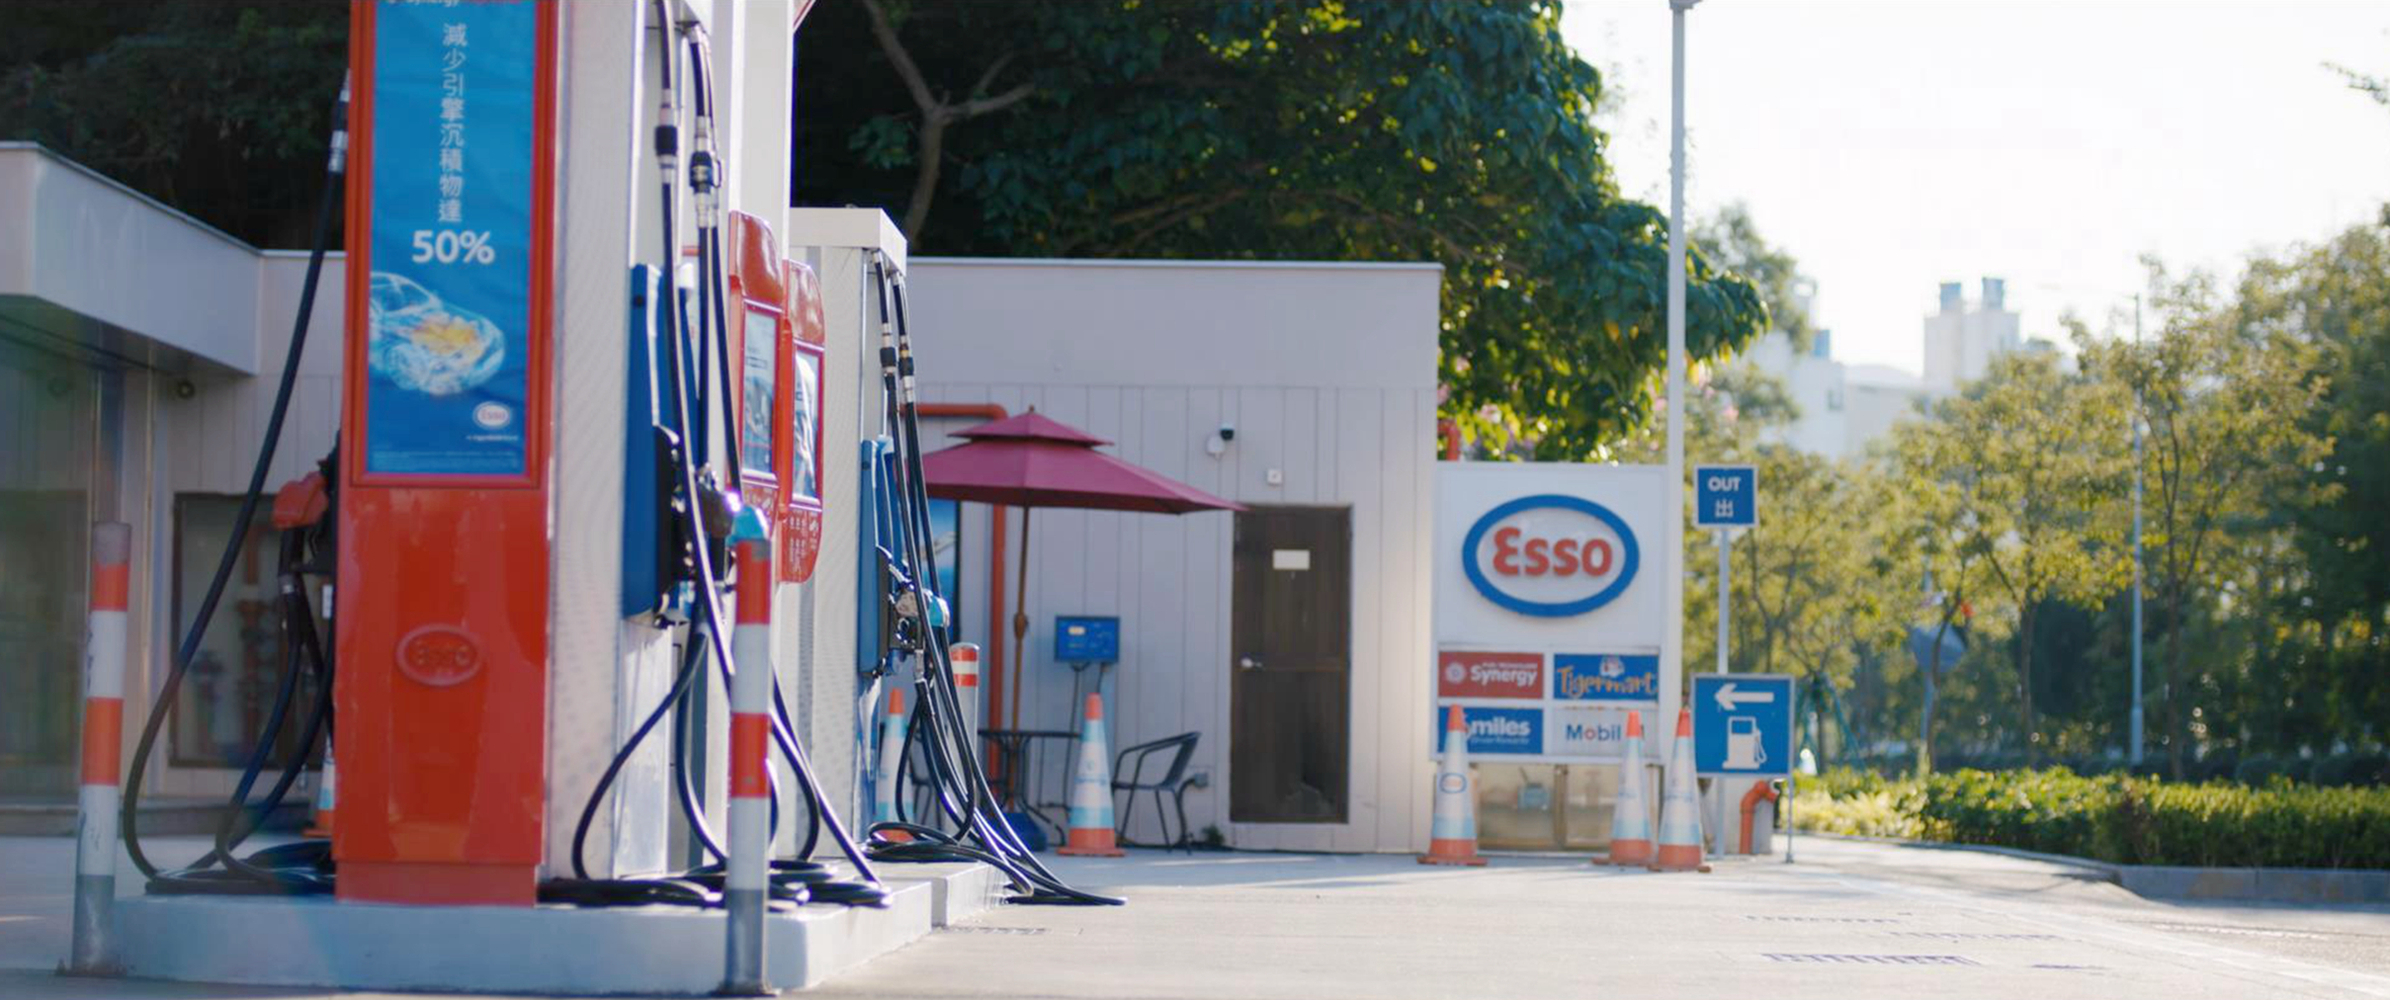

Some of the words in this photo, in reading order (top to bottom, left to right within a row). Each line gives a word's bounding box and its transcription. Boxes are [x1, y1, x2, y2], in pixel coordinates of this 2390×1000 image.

[439, 23, 468, 221] 減少引擎沉積物達
[412, 229, 495, 264] 50%
[1708, 476, 1741, 491] OUT
[1715, 499, 1734, 518] 出
[1492, 527, 1613, 577] Esso
[1470, 664, 1538, 687] Synergy
[1557, 664, 1658, 699] Tigermart
[1566, 724, 1622, 741] Mobil
